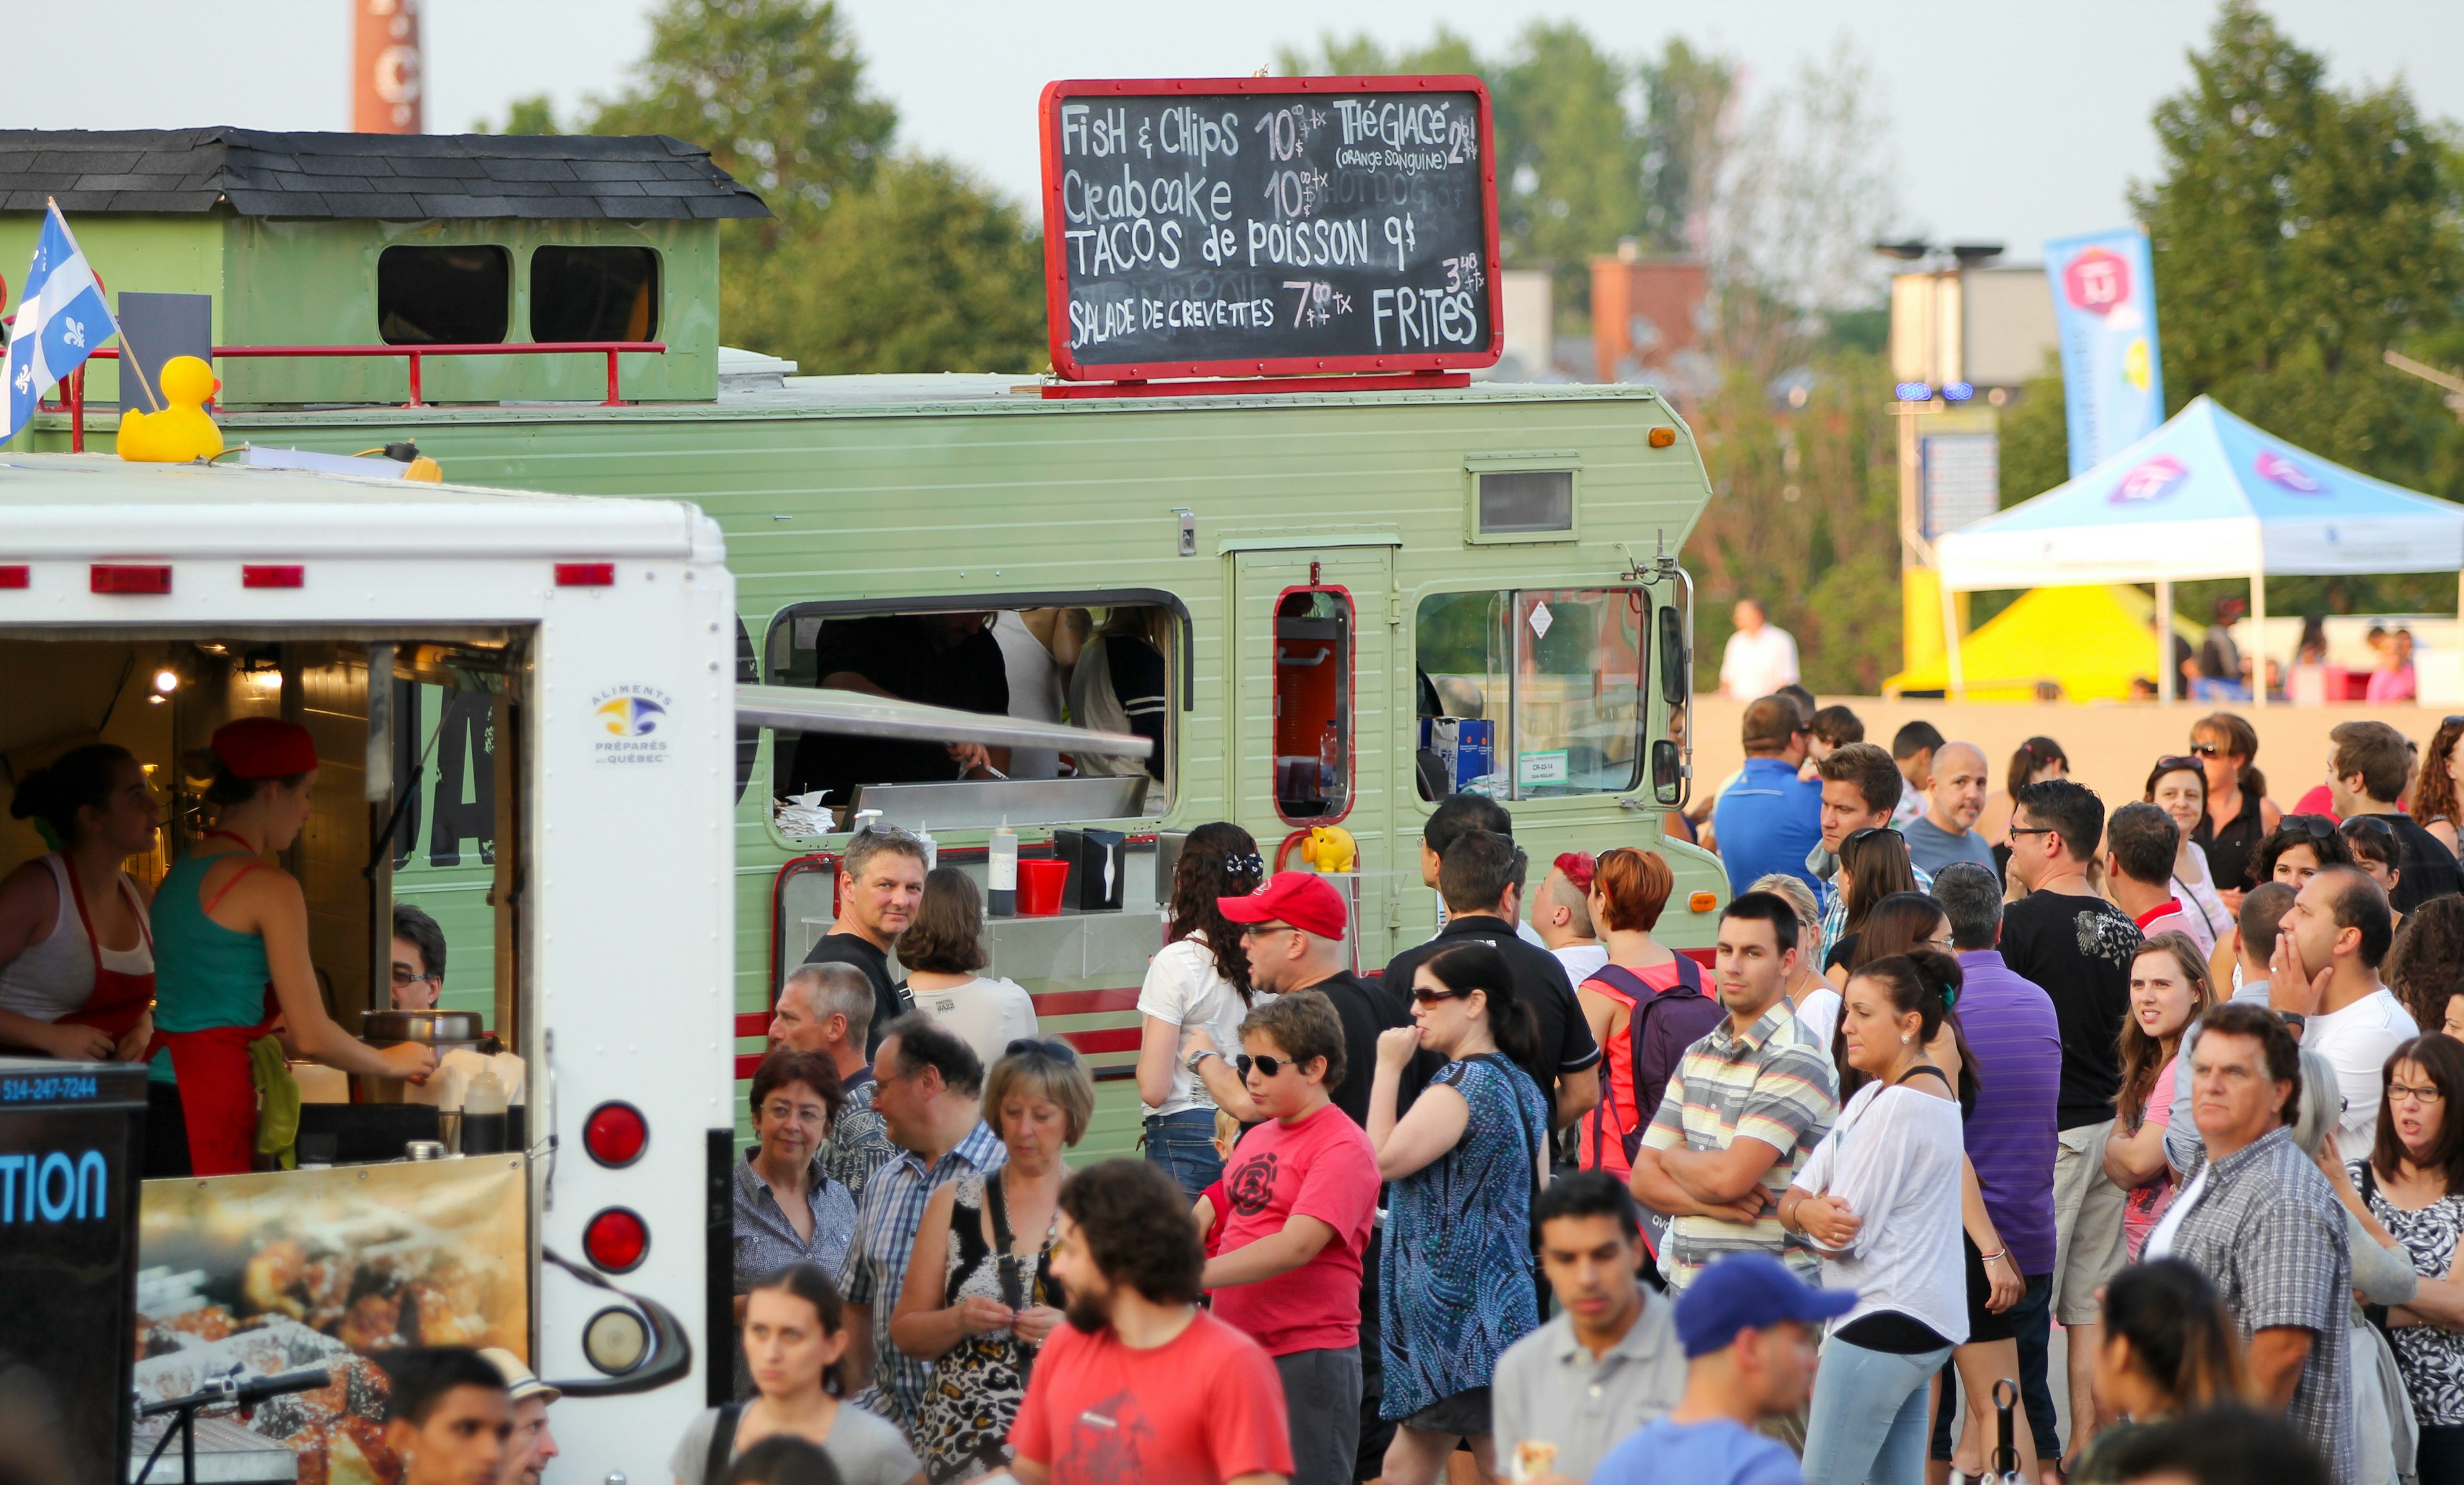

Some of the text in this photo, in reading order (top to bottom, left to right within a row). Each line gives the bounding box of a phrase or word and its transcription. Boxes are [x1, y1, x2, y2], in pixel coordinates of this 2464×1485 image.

[1138, 117, 1152, 159] &
[1065, 218, 1183, 276] TACOS
[1202, 223, 1238, 267] de
[1069, 298, 1137, 350] SALADE
[1142, 298, 1164, 330] DE
[1168, 298, 1274, 328] CREVETTES
[592, 685, 672, 706] ALIMENTS
[595, 740, 667, 752] PRÉPARÉS
[607, 753, 663, 765] QUÉBEC
